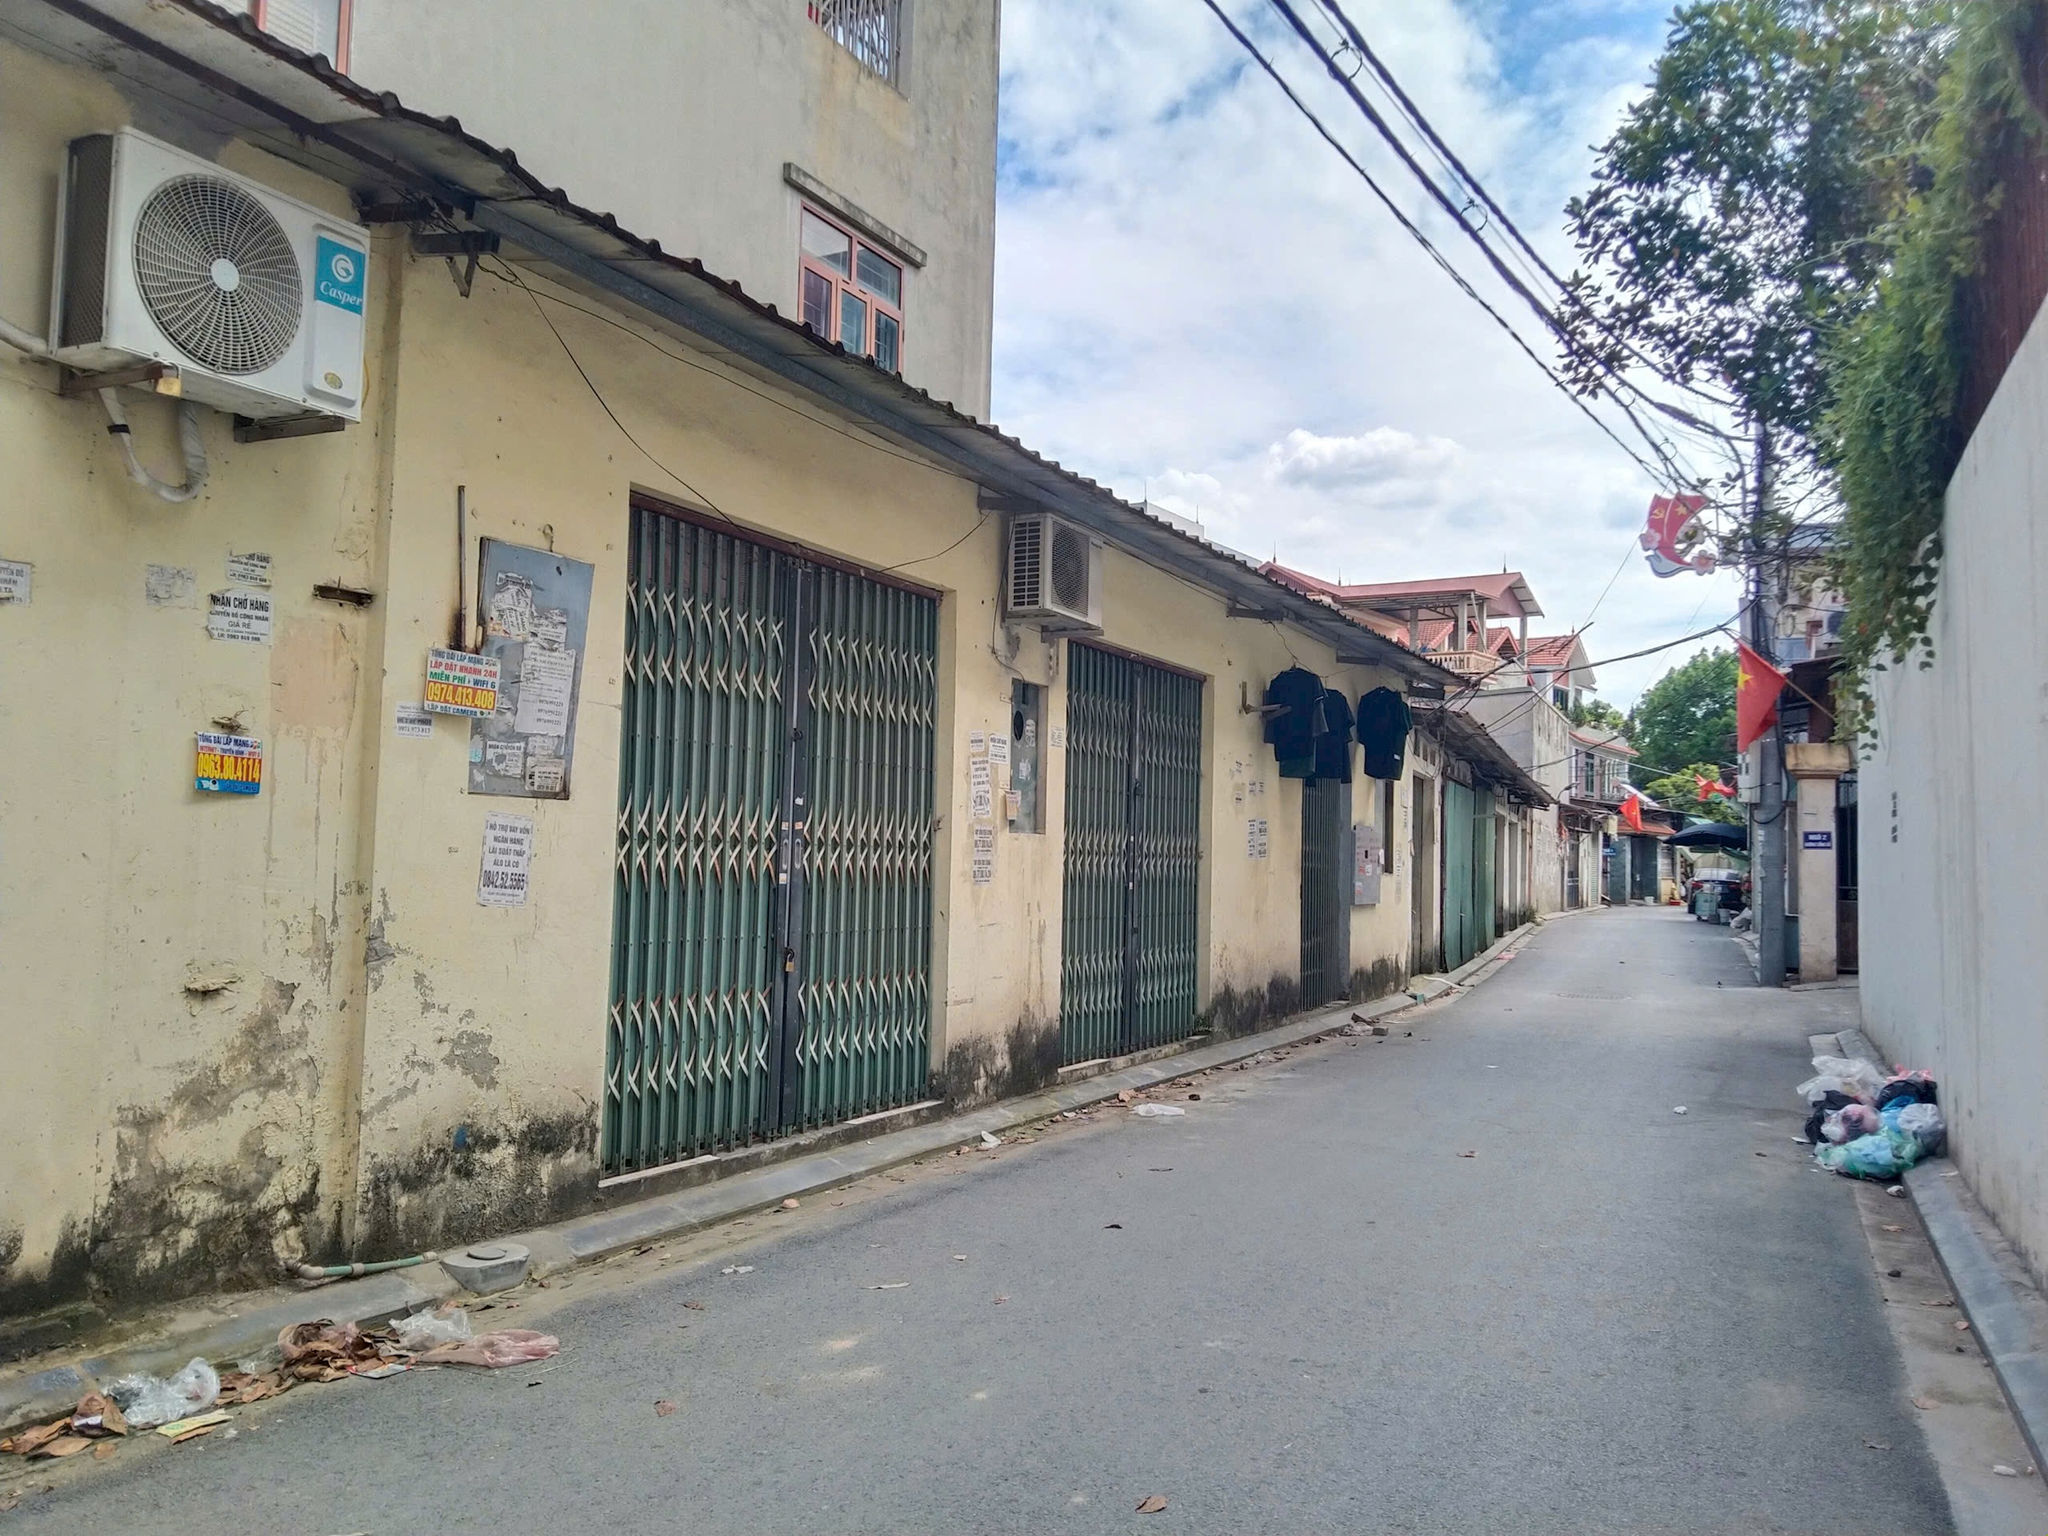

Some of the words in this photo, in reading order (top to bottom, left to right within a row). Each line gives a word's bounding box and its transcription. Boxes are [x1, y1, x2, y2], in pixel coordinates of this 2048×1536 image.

[320, 280, 363, 306] Casper
[233, 594, 248, 610] CHỞ
[249, 598, 270, 612] HÀNG
[459, 664, 482, 676] NHANH
[483, 668, 498, 679] 24H
[452, 675, 467, 685] PHÍ
[473, 678, 489, 689] WIFI
[490, 681, 497, 689] 6
[427, 682, 495, 710] 0974.413.408
[453, 707, 478, 717] CAMERA
[197, 752, 260, 783] 0963.80.4114
